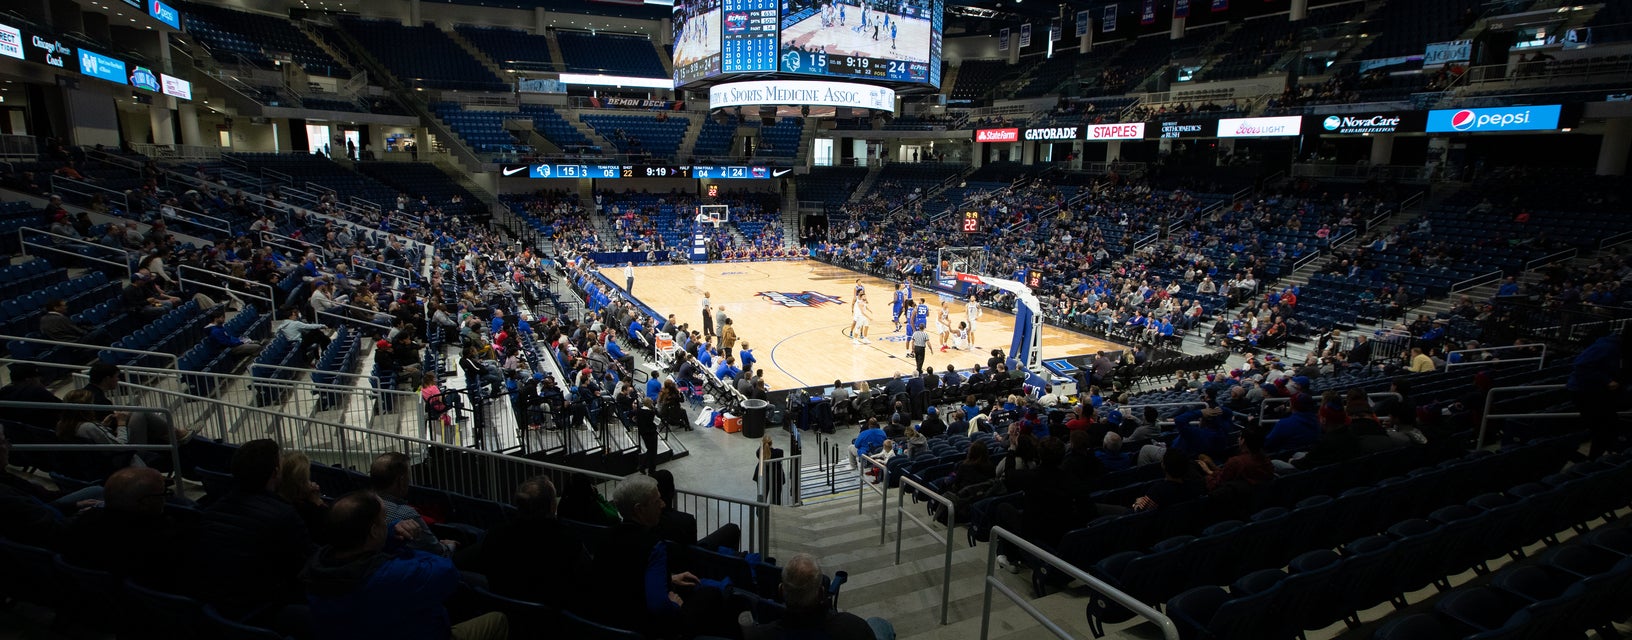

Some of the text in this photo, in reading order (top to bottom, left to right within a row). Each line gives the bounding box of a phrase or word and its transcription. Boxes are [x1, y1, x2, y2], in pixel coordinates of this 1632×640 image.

[810, 54, 826, 67] 15
[847, 57, 869, 68] 9:19
[889, 62, 905, 73] 24
[723, 92, 728, 103] &
[731, 87, 762, 102] SPORTS
[766, 86, 819, 101] MEDICINE
[824, 88, 860, 104] ASSOC.
[607, 98, 640, 106] DEMON
[1340, 115, 1400, 127] NovaCare
[1477, 110, 1530, 127] pepsi
[1025, 128, 1077, 140] GATORADE
[1094, 126, 1137, 138] STAPLES
[1236, 122, 1260, 134] Coors
[563, 167, 574, 176] 15
[647, 168, 666, 176] 9:19
[965, 219, 977, 230] 22
